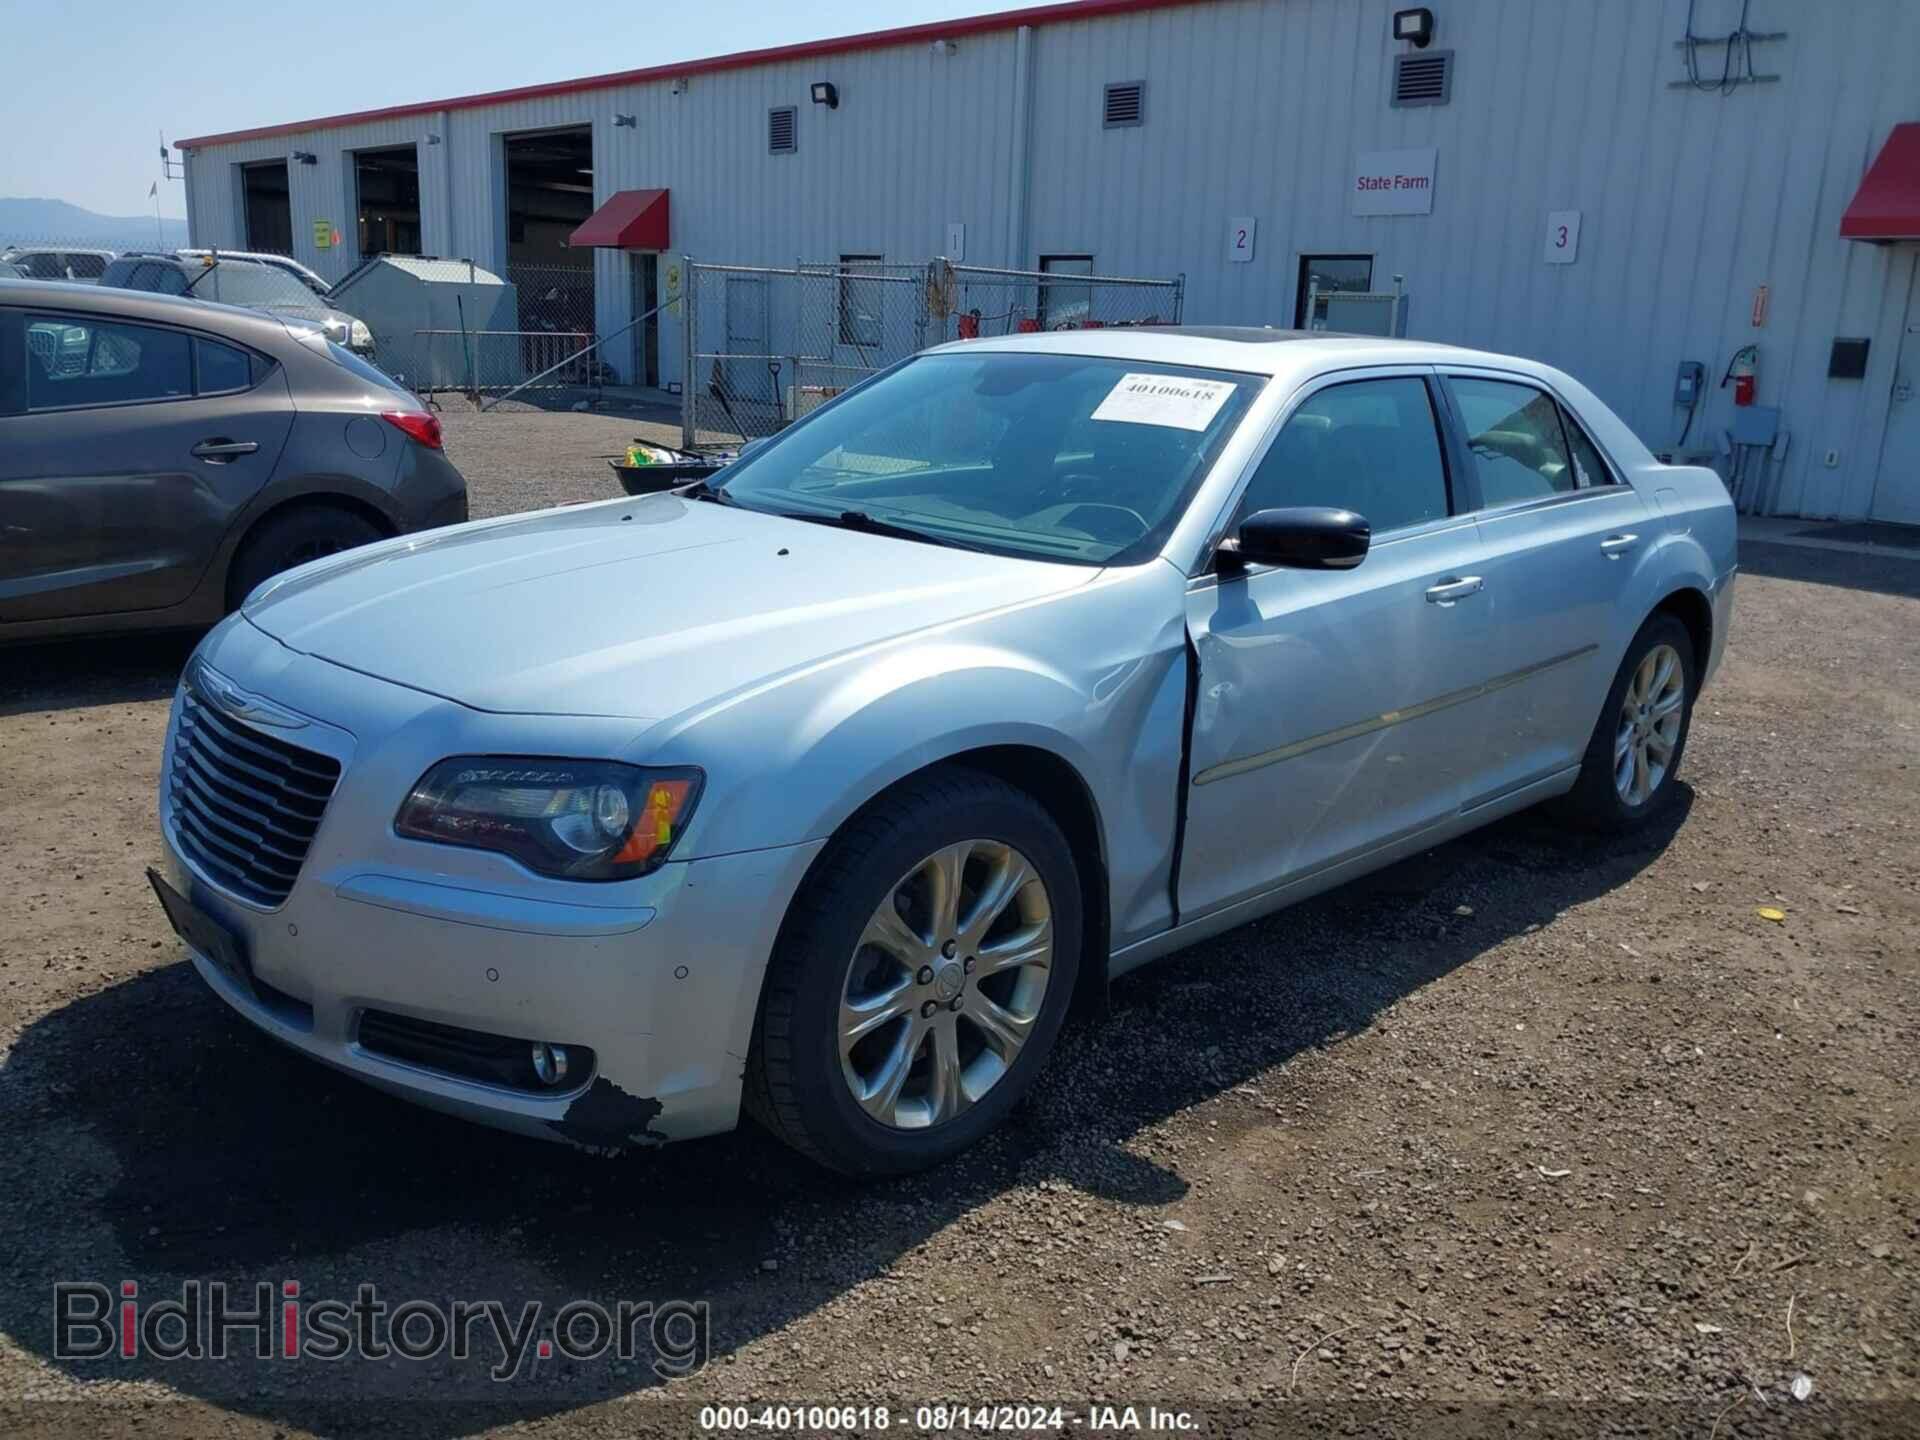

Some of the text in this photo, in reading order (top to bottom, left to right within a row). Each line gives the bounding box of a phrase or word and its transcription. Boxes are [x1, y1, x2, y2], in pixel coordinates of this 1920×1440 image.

[1356, 174, 1430, 191] State Farm
[1236, 229, 1247, 249] 2
[1555, 225, 1568, 249] 3
[1127, 383, 1216, 400] 40100618
